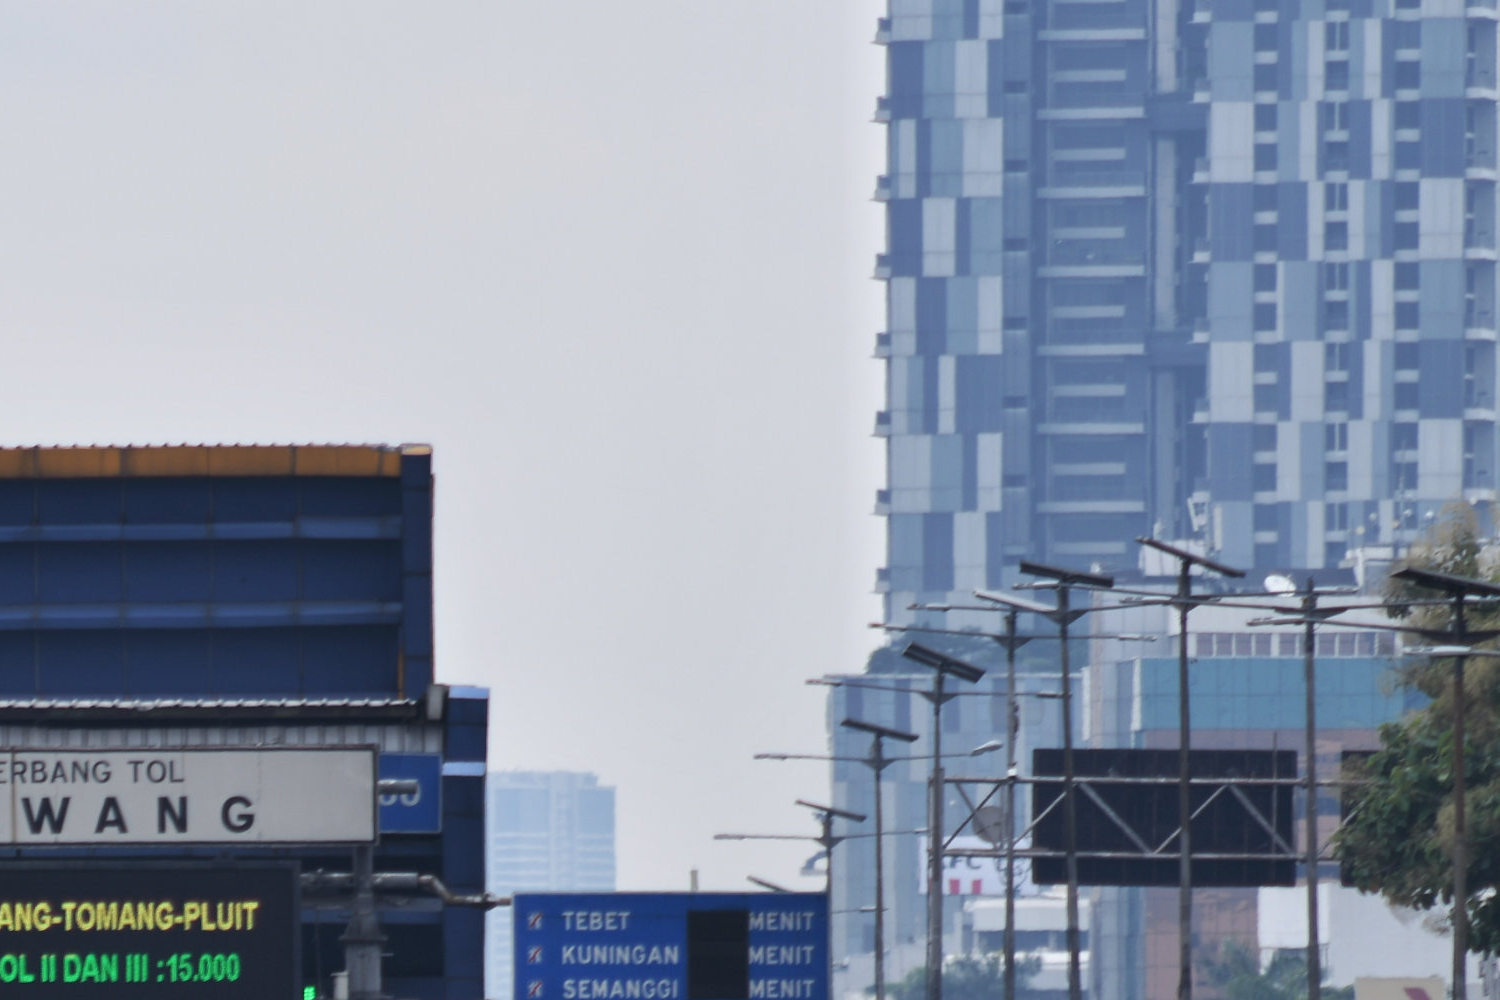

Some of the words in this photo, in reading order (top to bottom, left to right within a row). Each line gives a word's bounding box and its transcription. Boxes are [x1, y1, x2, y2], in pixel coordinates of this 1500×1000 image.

[128, 760, 184, 783] TOL
[561, 911, 630, 931] TEBET
[749, 911, 815, 931] MENIT
[561, 945, 679, 965] KUNINGAN
[749, 945, 815, 965] MENIT
[41, 953, 56, 983] II
[63, 953, 118, 983] DAN
[125, 953, 149, 983] III
[563, 979, 678, 999] SEMANGGI
[749, 979, 815, 999] MENIT
